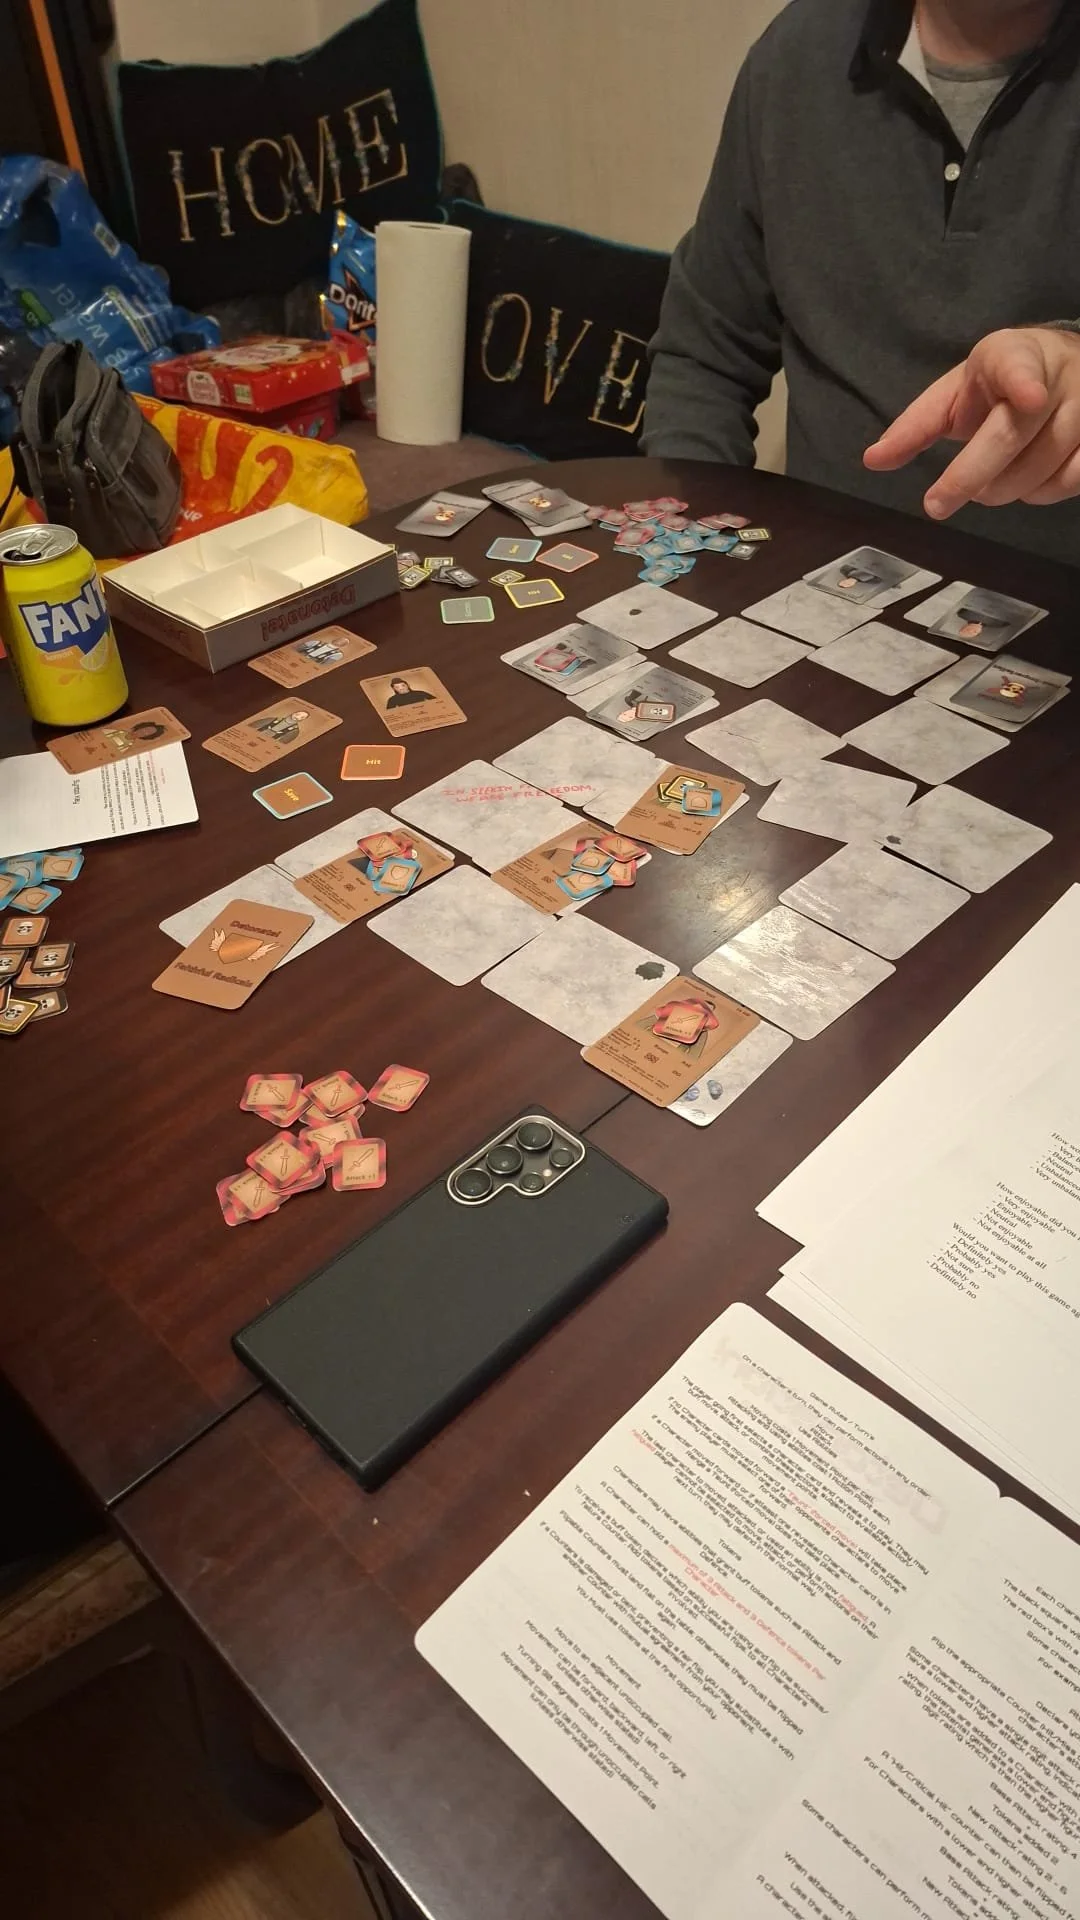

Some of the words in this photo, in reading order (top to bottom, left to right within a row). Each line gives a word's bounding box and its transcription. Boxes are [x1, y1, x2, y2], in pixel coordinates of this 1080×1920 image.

[168, 89, 408, 241] HOME
[330, 283, 377, 321] Dorit
[481, 293, 646, 433] OVE
[261, 584, 357, 641] Detonate!
[229, 918, 282, 938] Detonate!
[1051, 1131, 1068, 1146] How
[1059, 1145, 1075, 1159] Very
[1045, 1156, 1073, 1176] Neutral
[1051, 1151, 1080, 1173] Balance
[1035, 1167, 1051, 1180] Very
[1051, 1179, 1080, 1201] unbalan
[989, 1207, 1018, 1228] Neutral
[996, 1181, 1014, 1195] How
[1013, 1194, 1048, 1218] enjoyable
[1048, 1217, 1063, 1227] did
[1059, 1225, 1077, 1237] you
[996, 1201, 1035, 1228] Enjoyable
[1004, 1195, 1020, 1209] Very
[1020, 1209, 1055, 1233] enjoyable
[976, 1219, 991, 1232] Not
[991, 1230, 1026, 1255] enjoyable
[1034, 1260, 1047, 1269] all
[983, 1213, 998, 1226] Not
[997, 1224, 1032, 1249] enjoyable
[936, 1256, 969, 1282] Probably
[943, 1249, 959, 1263] Not
[957, 1261, 975, 1274] sure
[949, 1243, 983, 1269] Probably
[980, 1267, 996, 1279] yes
[952, 1222, 976, 1241] Would
[972, 1240, 989, 1252] you
[990, 1250, 1008, 1265] want
[1015, 1269, 1034, 1283] play
[1034, 1281, 1049, 1294] this
[1047, 1293, 1071, 1309] game
[956, 1237, 993, 1265] Definitely
[991, 1264, 1006, 1275] yes
[929, 1262, 966, 1291] Definitely
